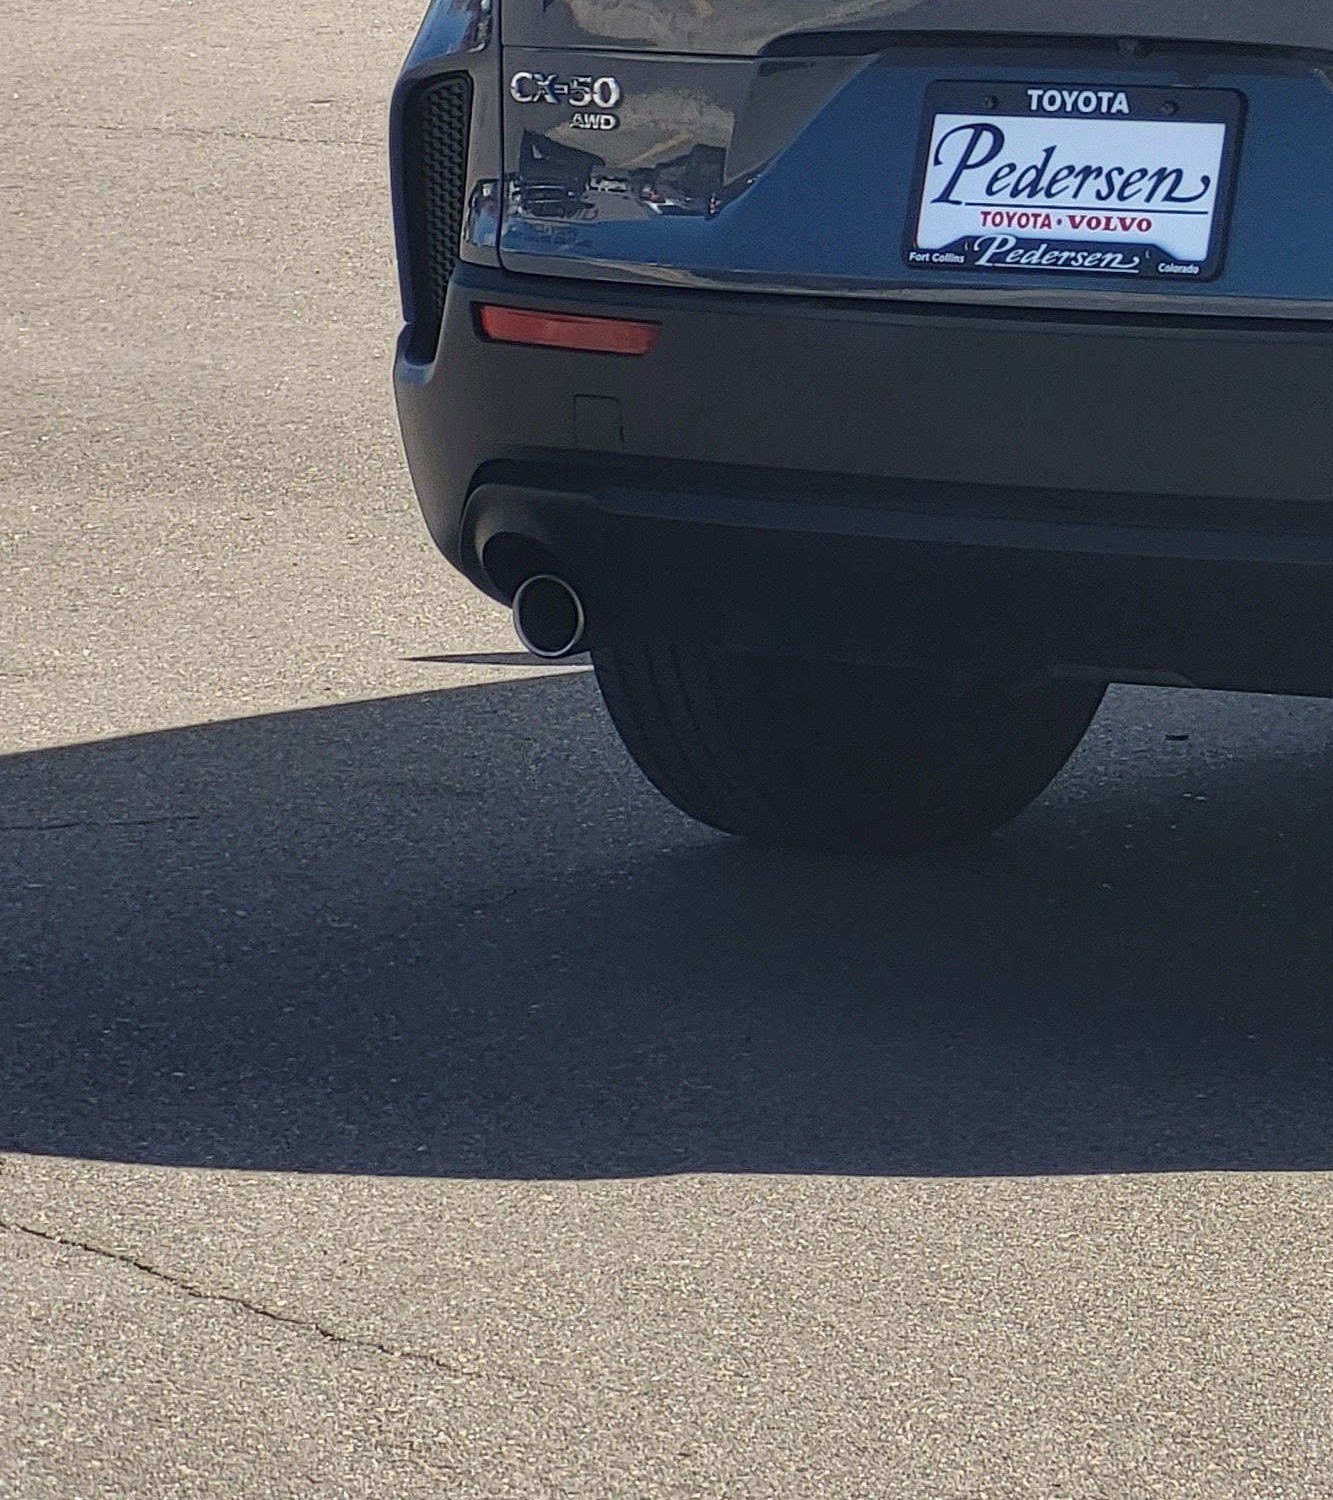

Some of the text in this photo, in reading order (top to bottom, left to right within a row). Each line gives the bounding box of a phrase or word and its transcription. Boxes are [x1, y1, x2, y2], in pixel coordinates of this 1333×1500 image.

[510, 71, 621, 108] CX-50
[1027, 88, 1131, 115] TOYOTA
[569, 112, 618, 130] AWD
[930, 122, 1212, 206] Pedersen
[980, 211, 1153, 233] TOYOTA VOLVO
[908, 251, 965, 265] Fort Collins
[973, 234, 1141, 268] Pedersen
[1156, 262, 1200, 276] Colorado
